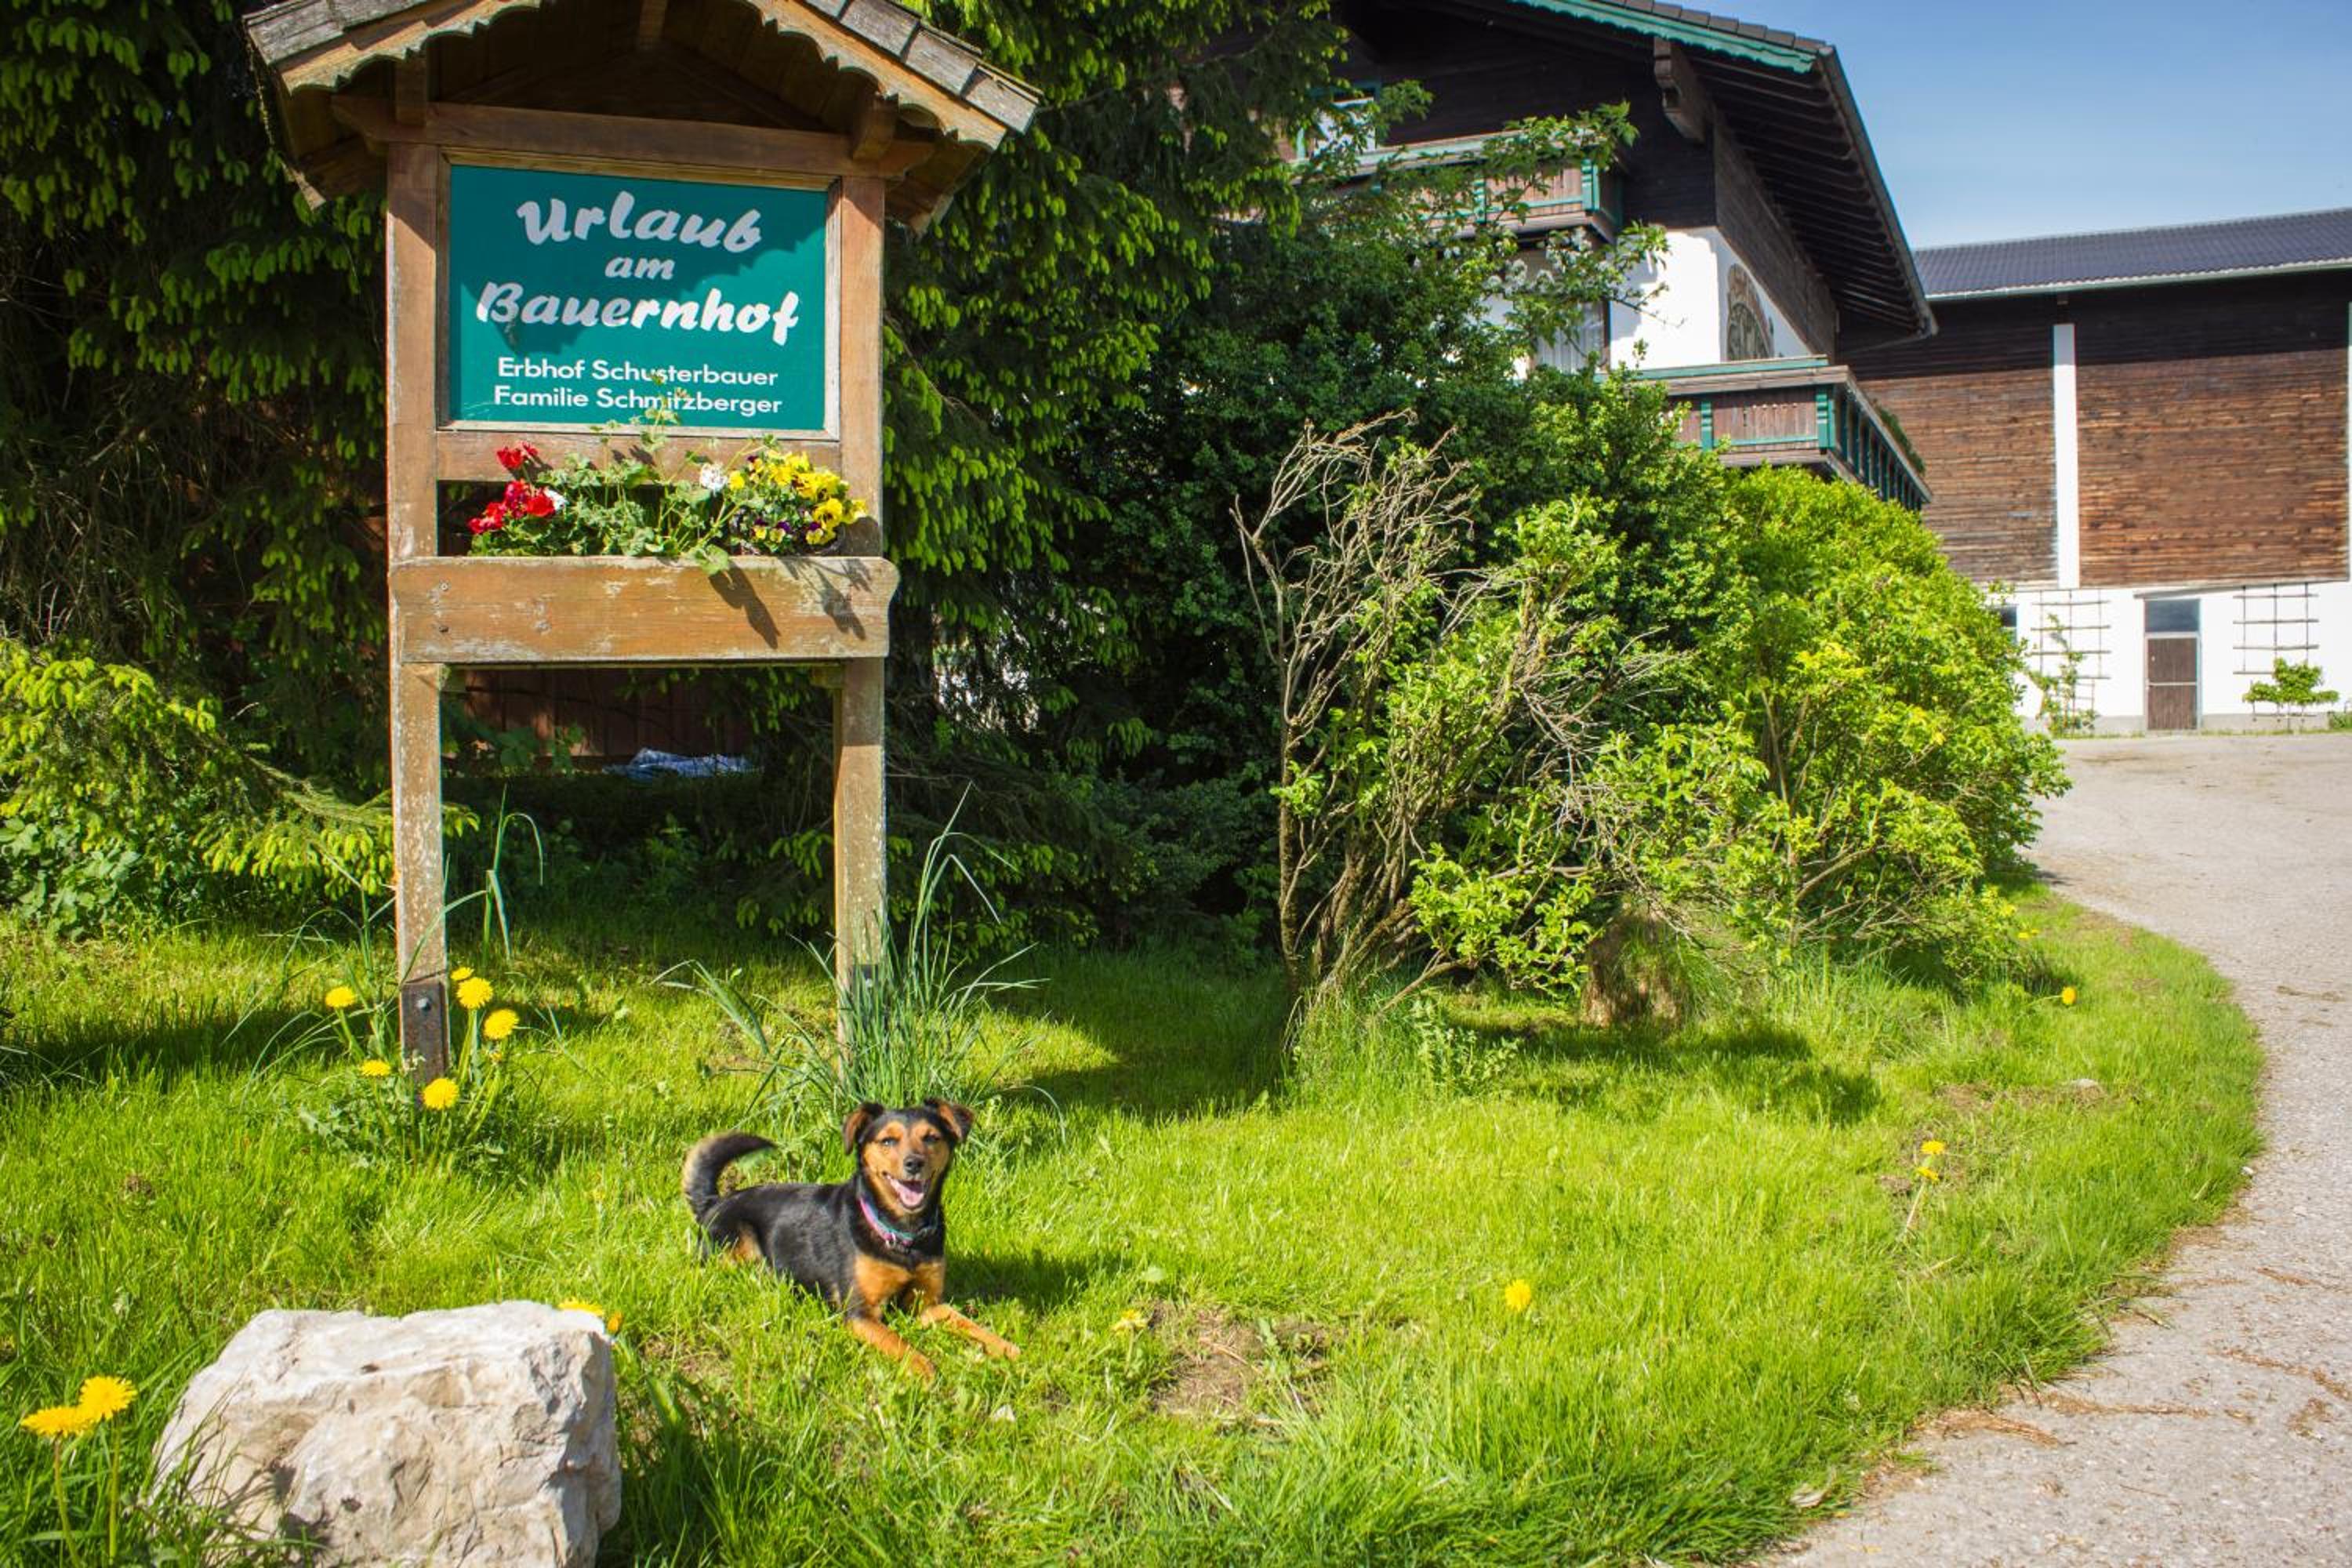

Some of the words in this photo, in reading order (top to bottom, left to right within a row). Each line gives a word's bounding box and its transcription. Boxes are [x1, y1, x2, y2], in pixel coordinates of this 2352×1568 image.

[517, 191, 762, 252] Urlaub
[604, 256, 675, 280] am
[476, 281, 800, 347] Bauernhof
[498, 357, 586, 379] Erbhof
[591, 359, 779, 387] Schusterbauer
[494, 385, 590, 408] Familie
